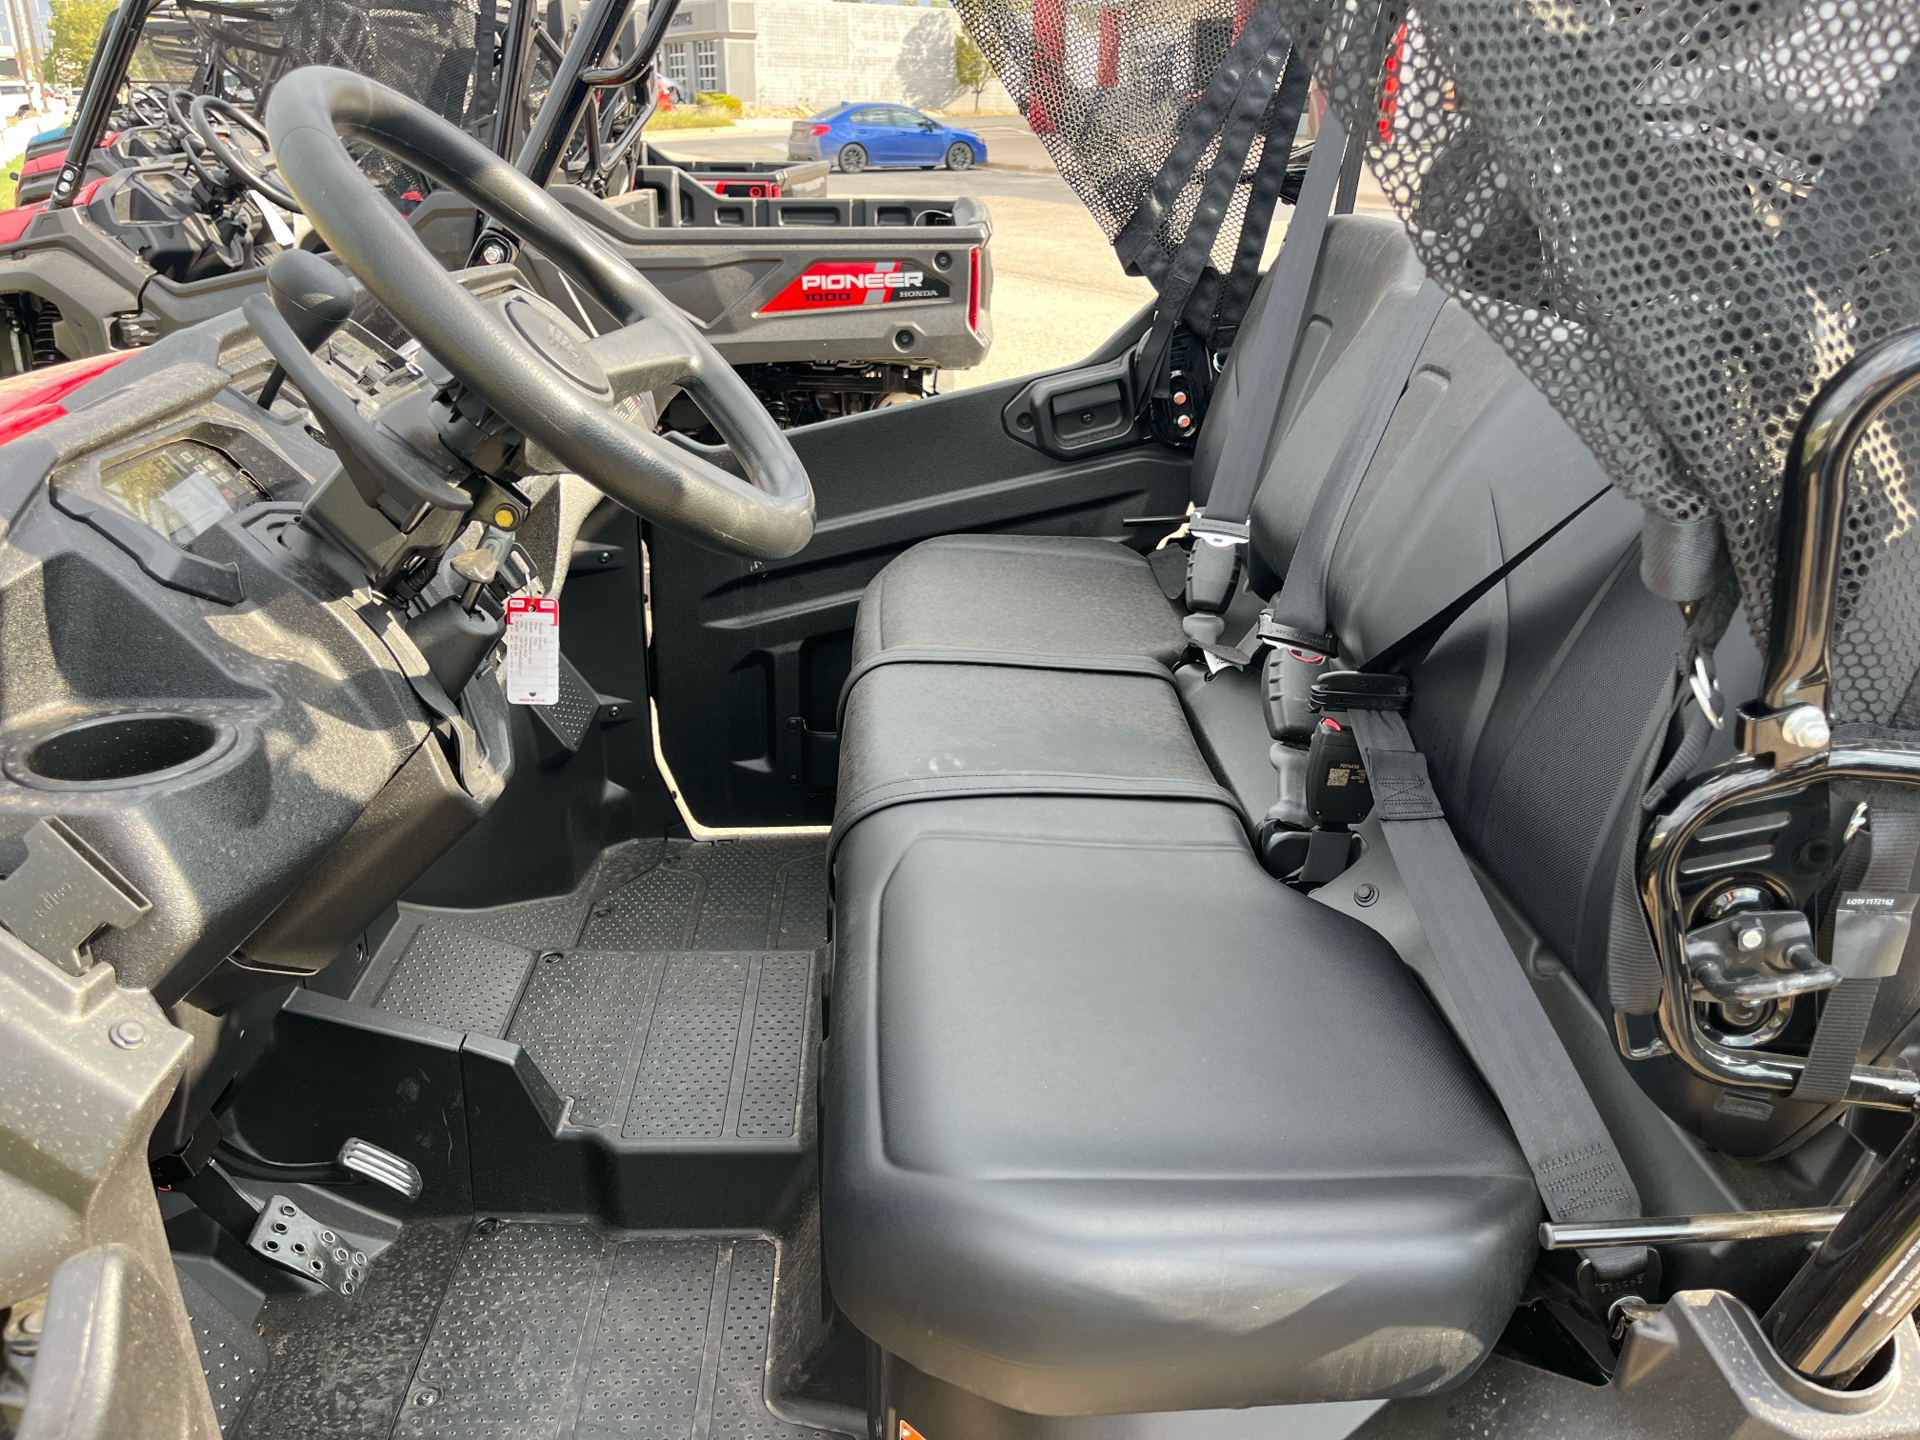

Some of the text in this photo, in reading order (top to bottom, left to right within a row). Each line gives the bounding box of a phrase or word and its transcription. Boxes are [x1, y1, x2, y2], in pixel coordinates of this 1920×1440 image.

[801, 271, 924, 291] PIONEER
[803, 292, 851, 302] 1000
[899, 289, 939, 298] HONDA
[1866, 898, 1895, 906] 1172162
